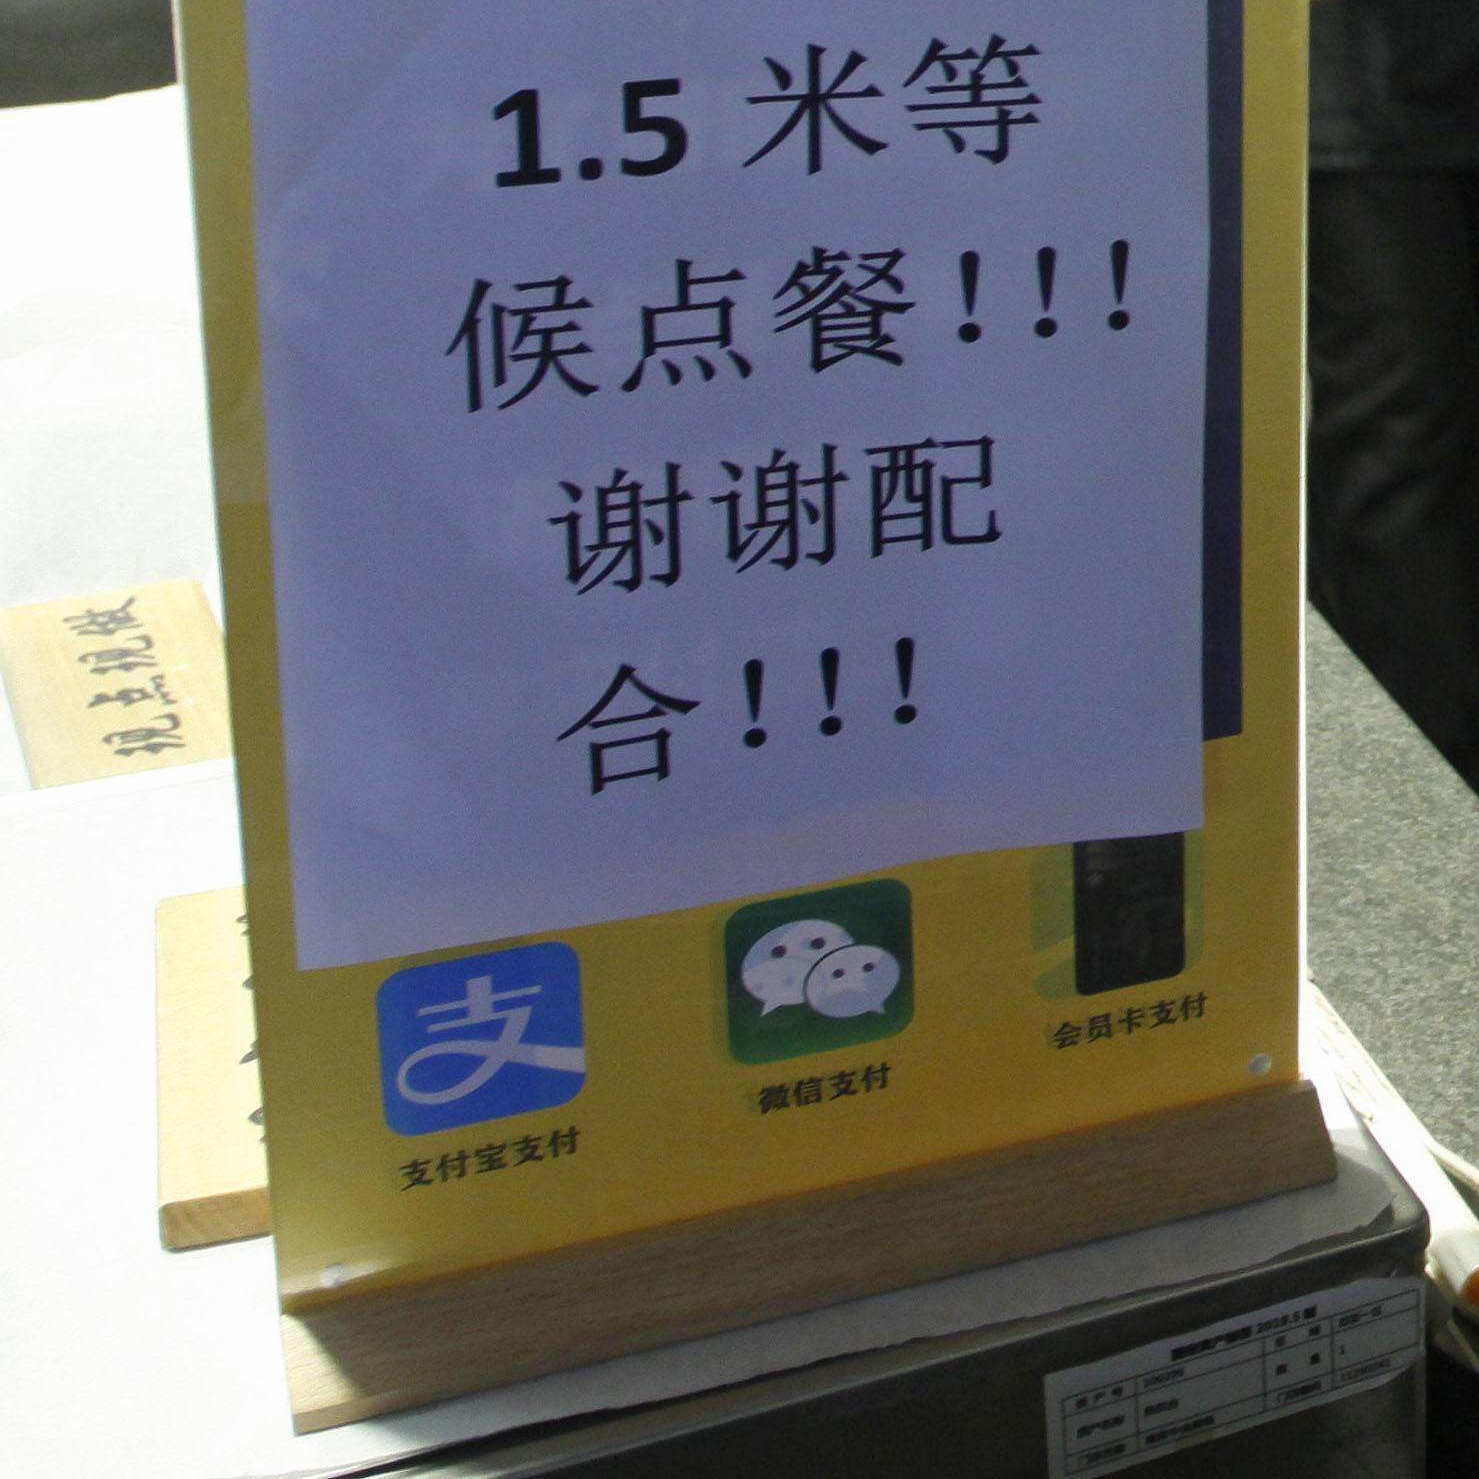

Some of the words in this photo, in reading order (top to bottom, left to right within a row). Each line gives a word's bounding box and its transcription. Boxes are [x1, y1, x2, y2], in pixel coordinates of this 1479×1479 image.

[493, 78, 690, 188] 1.5
[742, 33, 1043, 176] 米等
[547, 435, 1004, 596] 谢谢配
[1050, 992, 1209, 1052] 会员卡支付
[756, 1062, 893, 1117] 微信支付
[399, 1125, 582, 1192] 支付宝支付
